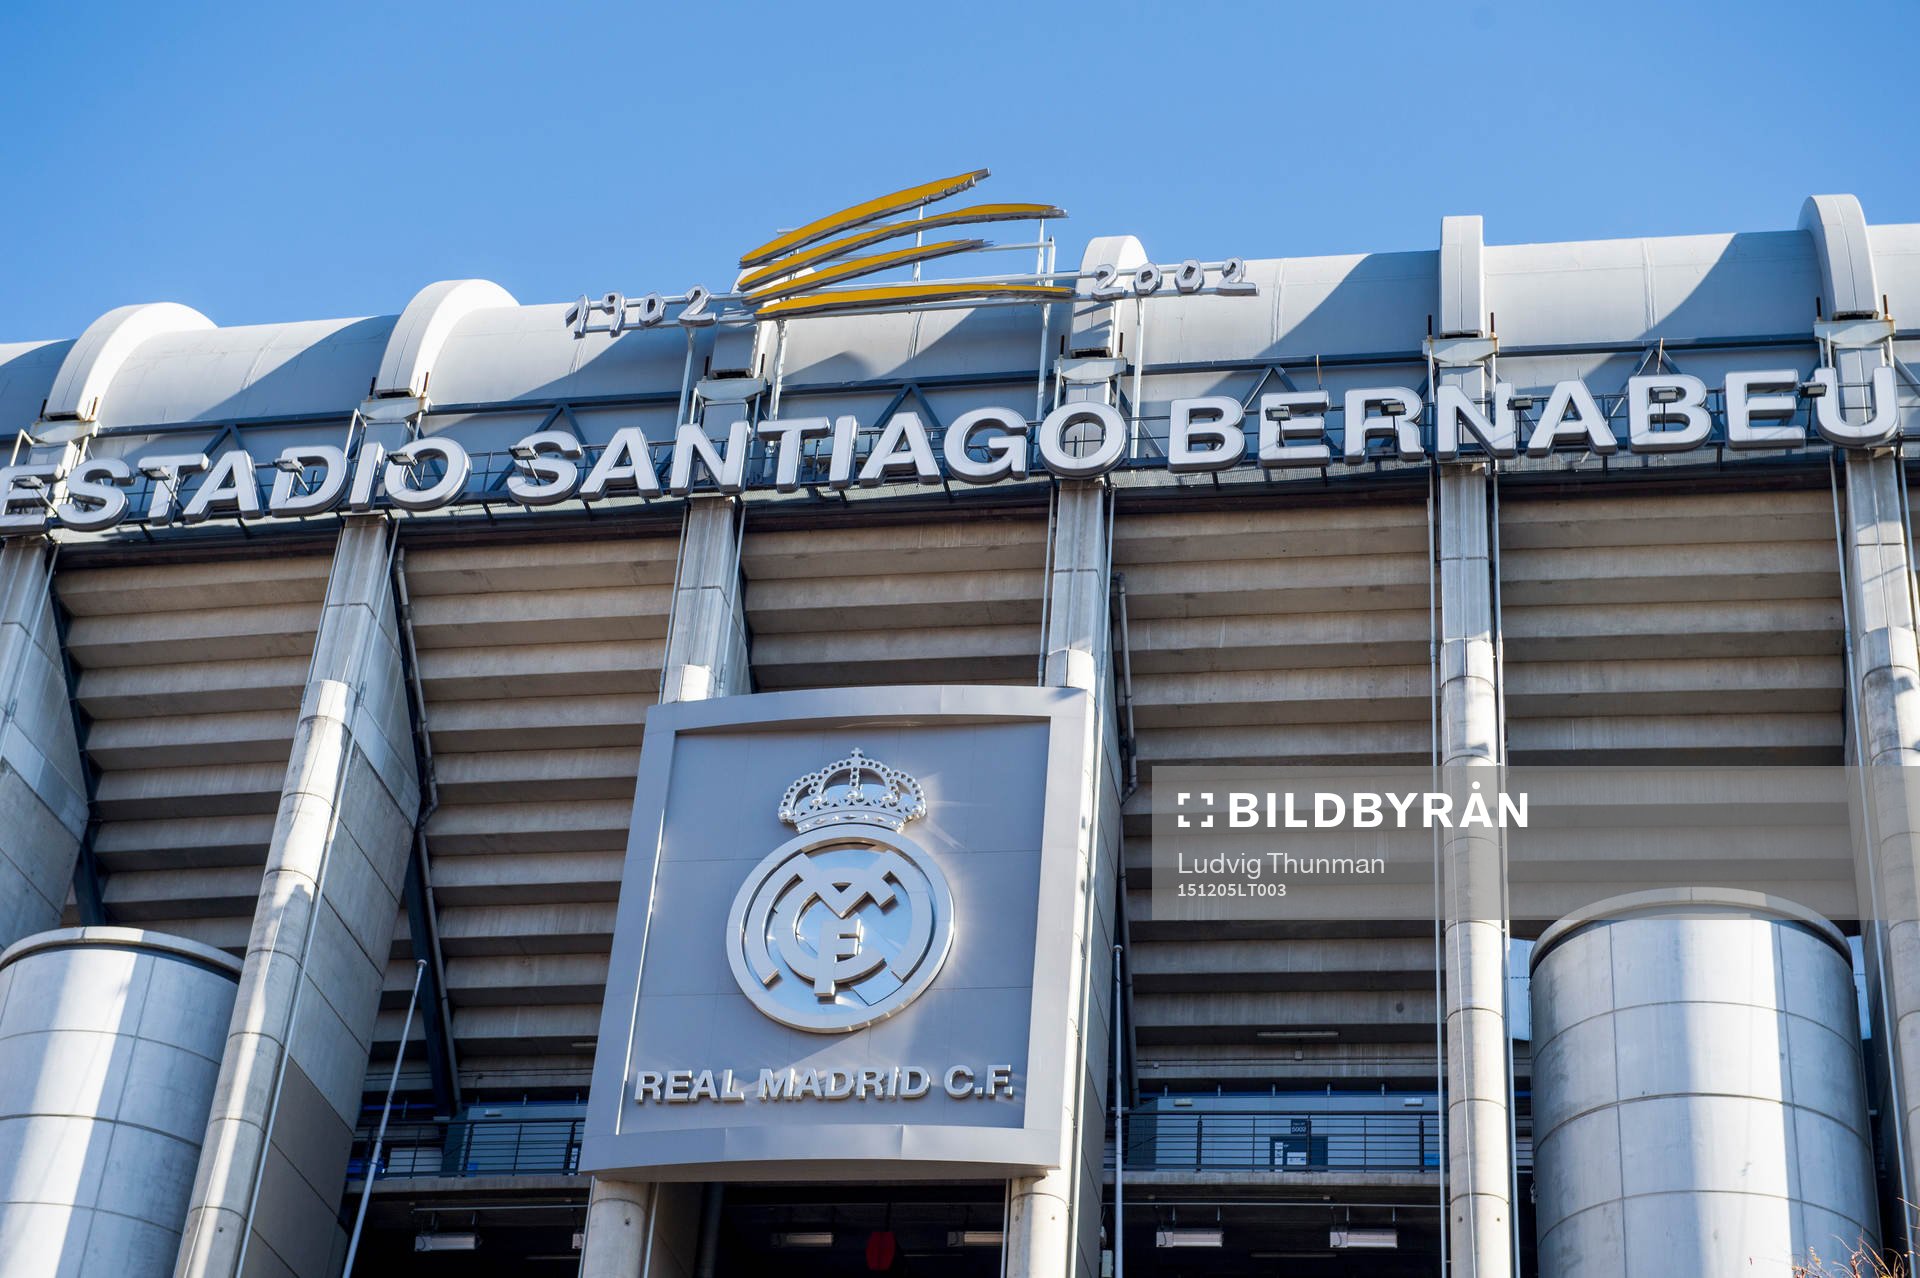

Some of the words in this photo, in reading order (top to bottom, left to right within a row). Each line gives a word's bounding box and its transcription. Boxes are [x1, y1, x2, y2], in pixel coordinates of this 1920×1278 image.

[1092, 256, 1258, 299] 2002
[565, 285, 717, 339] 1902
[507, 399, 1128, 505] SANTIAGO
[1167, 367, 1899, 472] BERNABEU
[634, 1069, 745, 1102] REAL
[757, 1065, 932, 1100] MADRID
[943, 1064, 1013, 1098] C.F.
